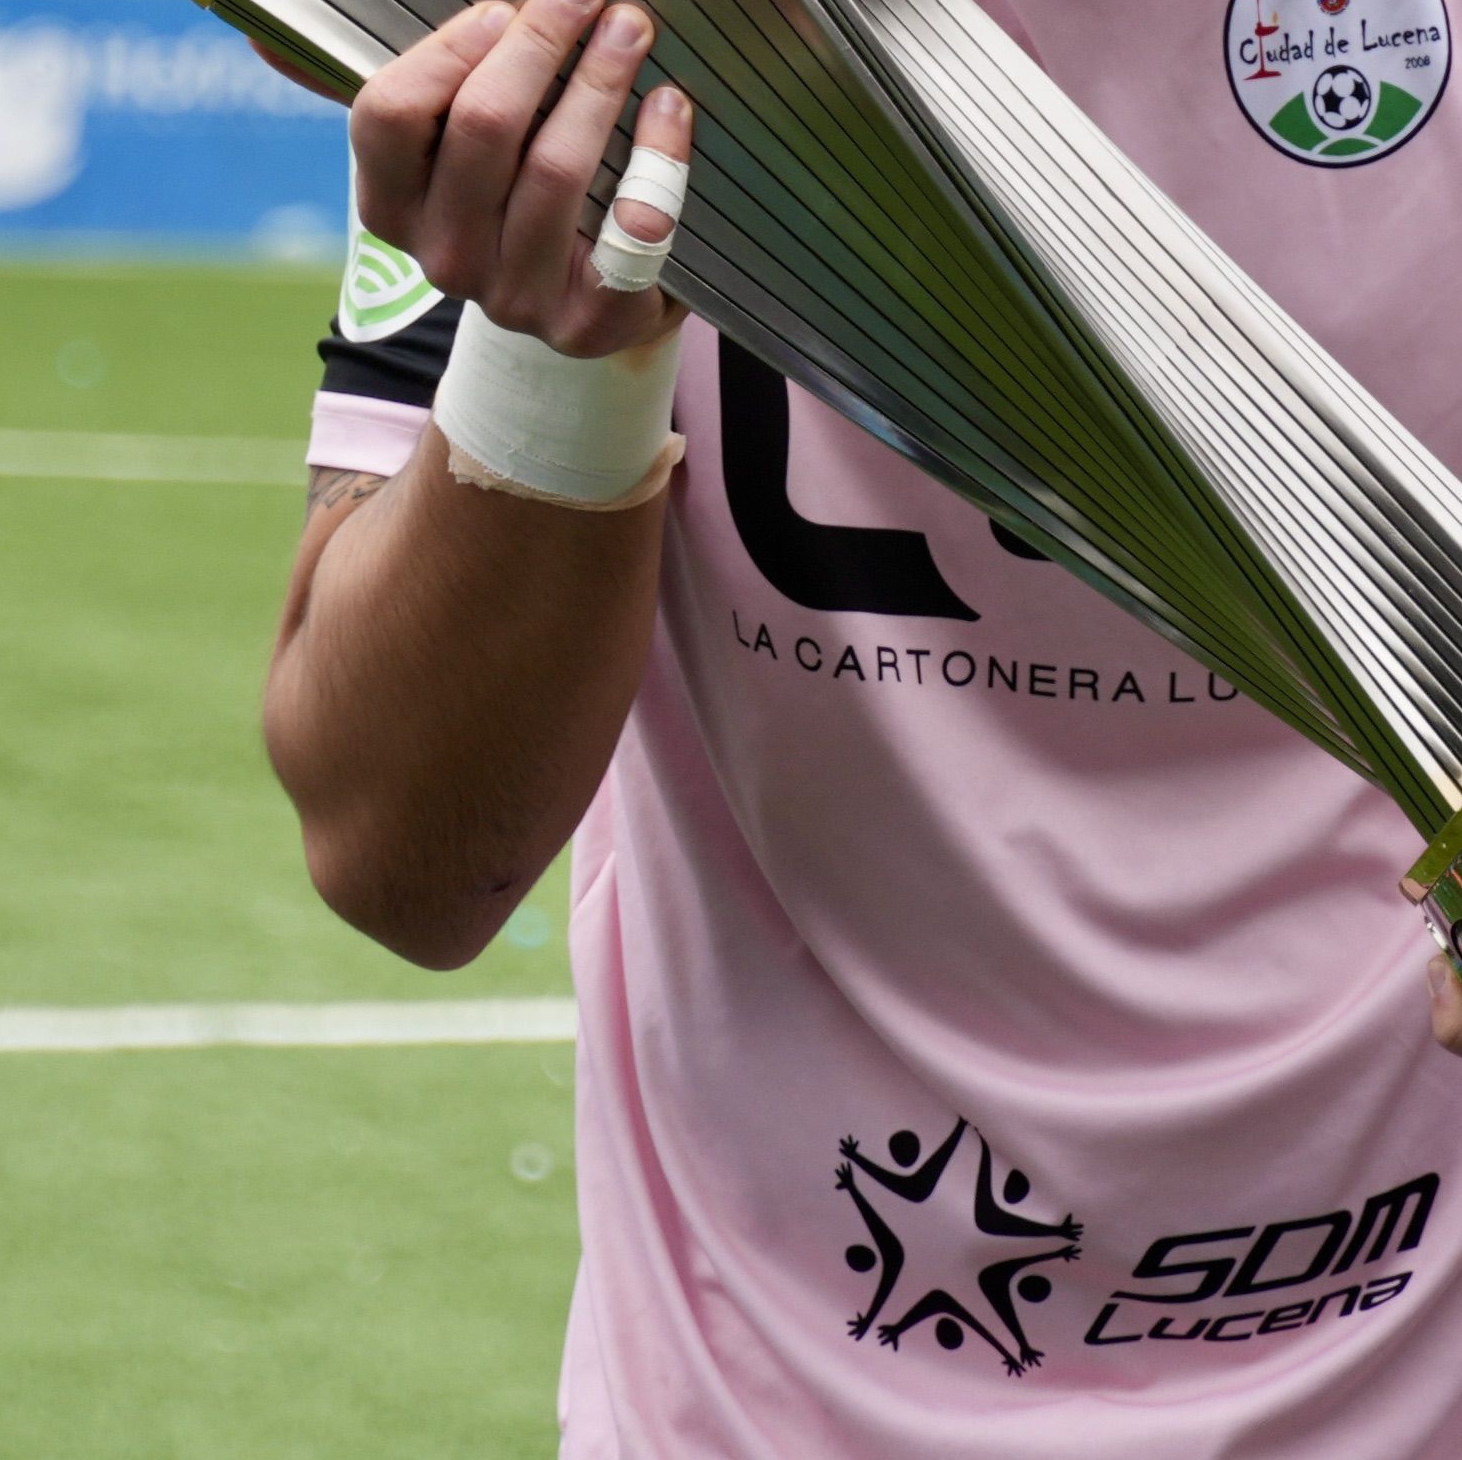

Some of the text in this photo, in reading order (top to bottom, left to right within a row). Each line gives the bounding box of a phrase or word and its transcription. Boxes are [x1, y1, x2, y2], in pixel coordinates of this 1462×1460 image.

[1324, 26, 1350, 56] de
[1360, 18, 1442, 53] Lucena
[732, 609, 779, 661] LA
[794, 636, 1146, 704] CARTONERA
[1110, 1171, 1440, 1304] SDM
[1084, 1271, 1413, 1345] Lucena
